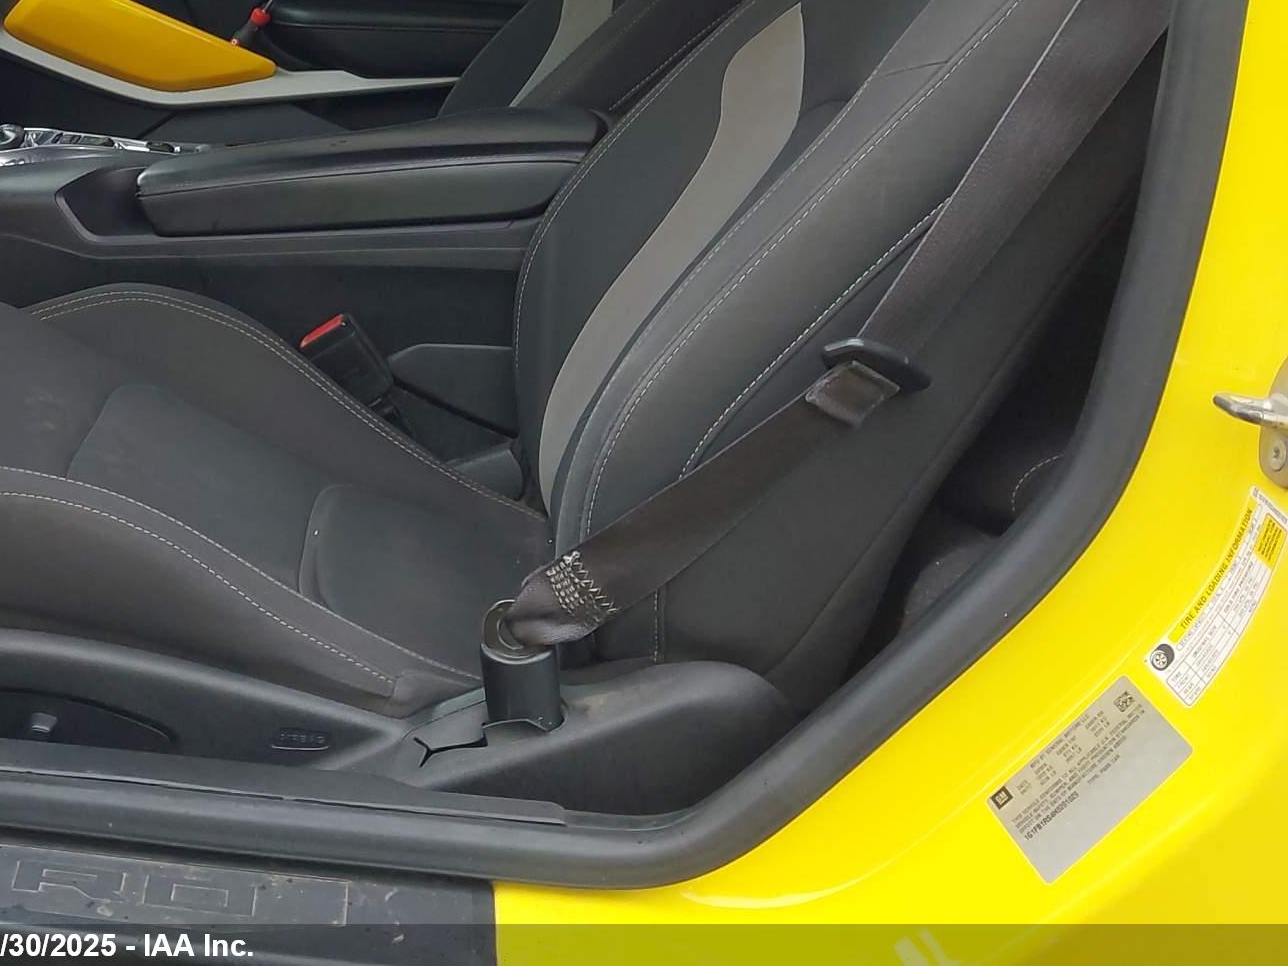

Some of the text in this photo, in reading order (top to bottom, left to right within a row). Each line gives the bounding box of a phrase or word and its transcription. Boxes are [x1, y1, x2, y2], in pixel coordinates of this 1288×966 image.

[1180, 507, 1253, 630] TIRE AND LOADING INFORMATION
